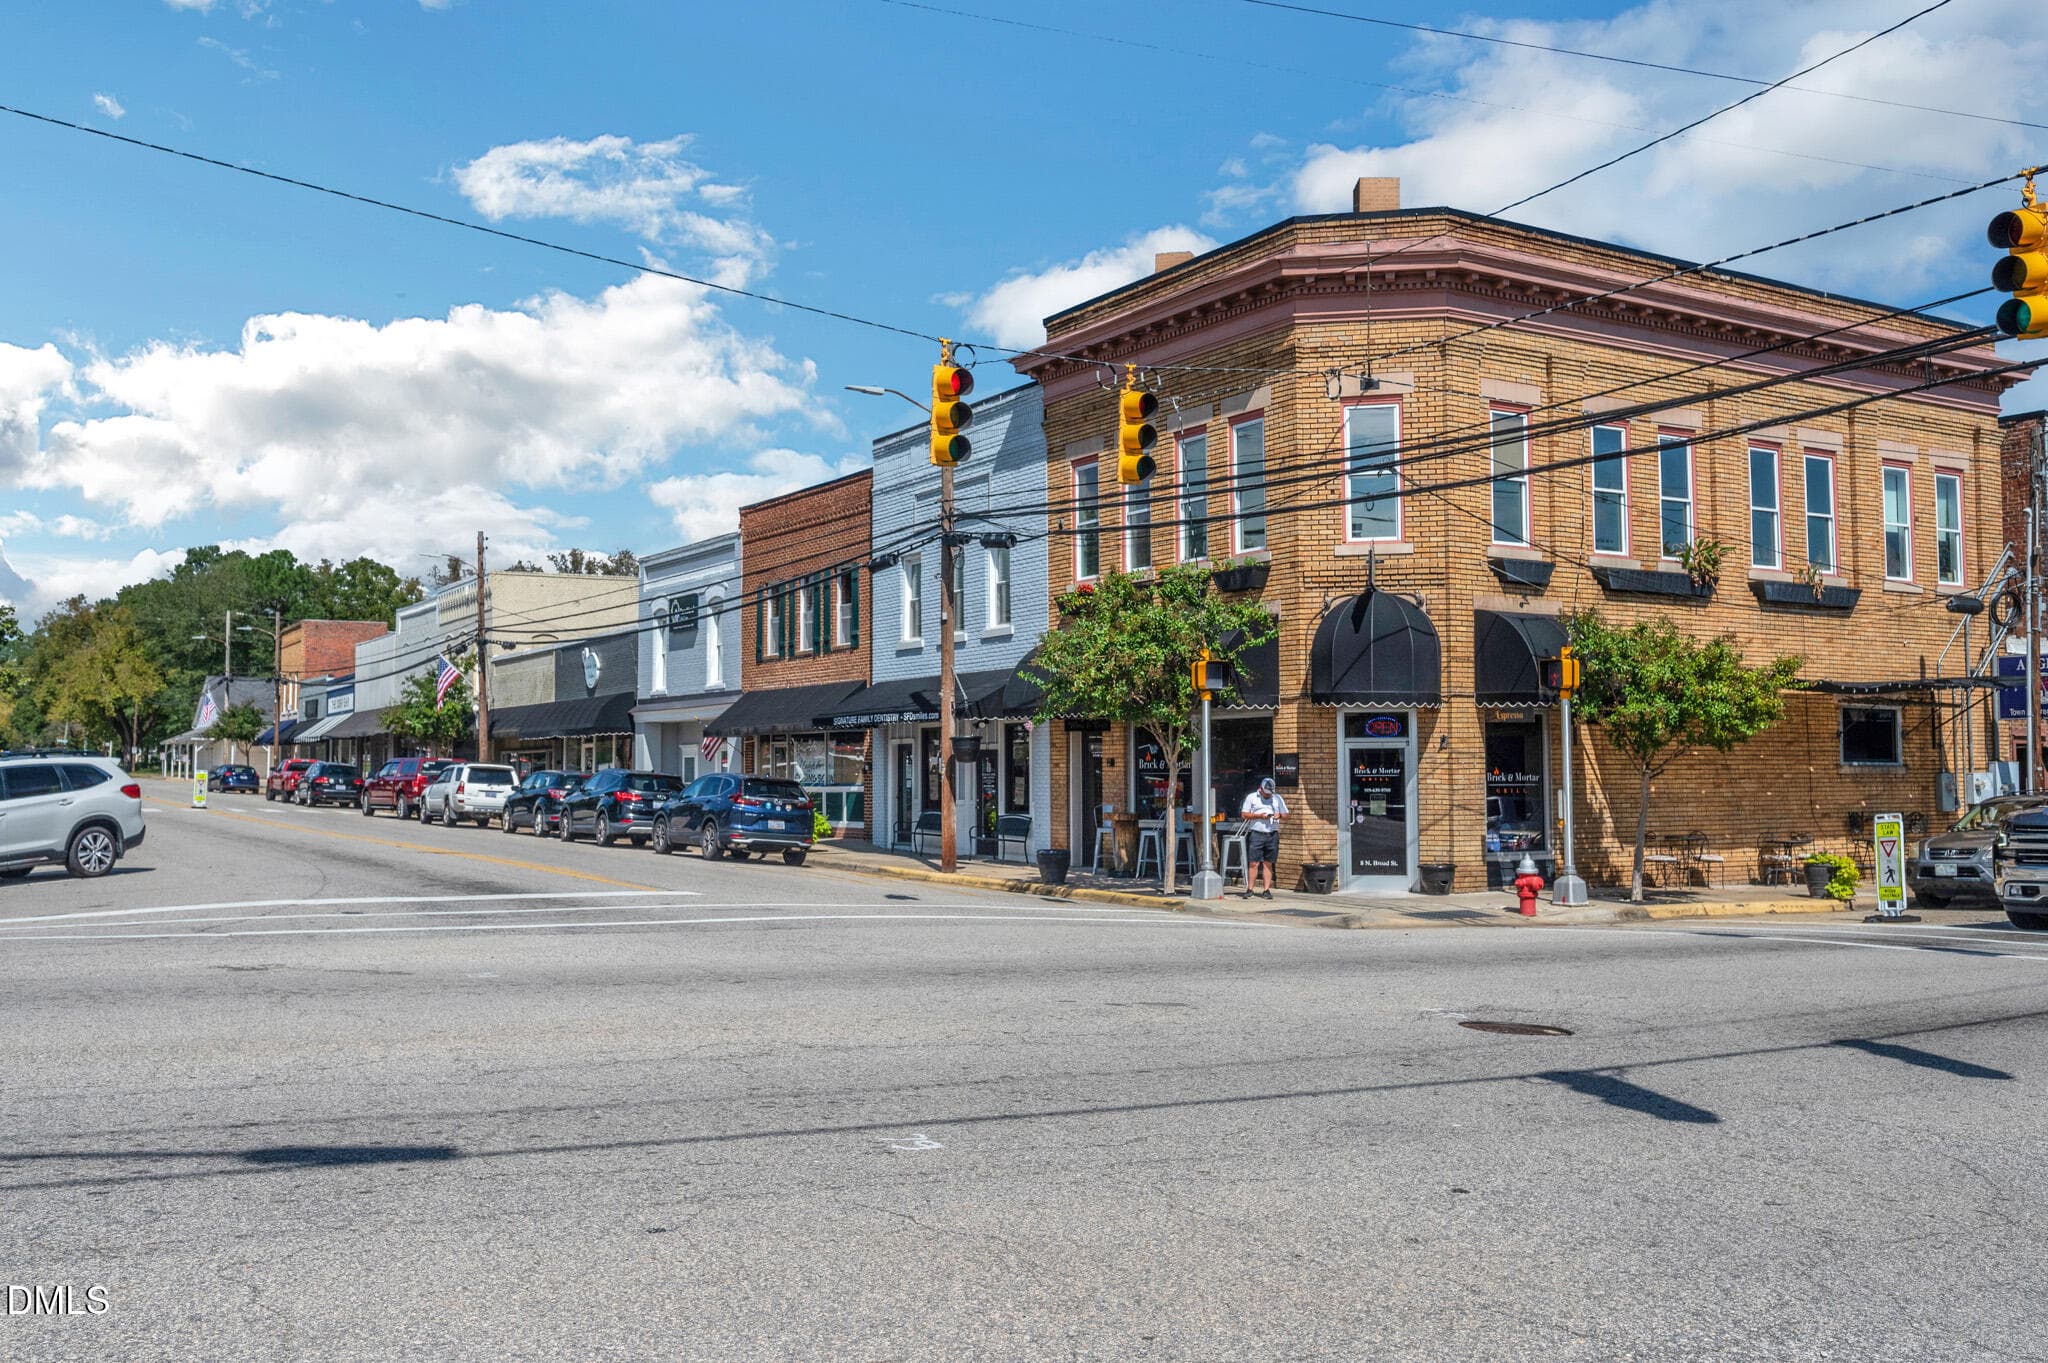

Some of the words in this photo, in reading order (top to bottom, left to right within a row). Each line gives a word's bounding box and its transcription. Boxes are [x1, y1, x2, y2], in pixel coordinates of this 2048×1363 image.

[2009, 708, 2026, 717] Town
[833, 716, 857, 725] SIGNATURE
[857, 714, 873, 724] FAMILY
[874, 713, 899, 723] DENTISTRY
[1369, 721, 1398, 735] OPEN
[1139, 759, 1158, 769] Brick
[1160, 760, 1165, 769] &
[1487, 772, 1506, 782] Brick
[1508, 773, 1514, 782] &
[1515, 772, 1540, 782] Mortar
